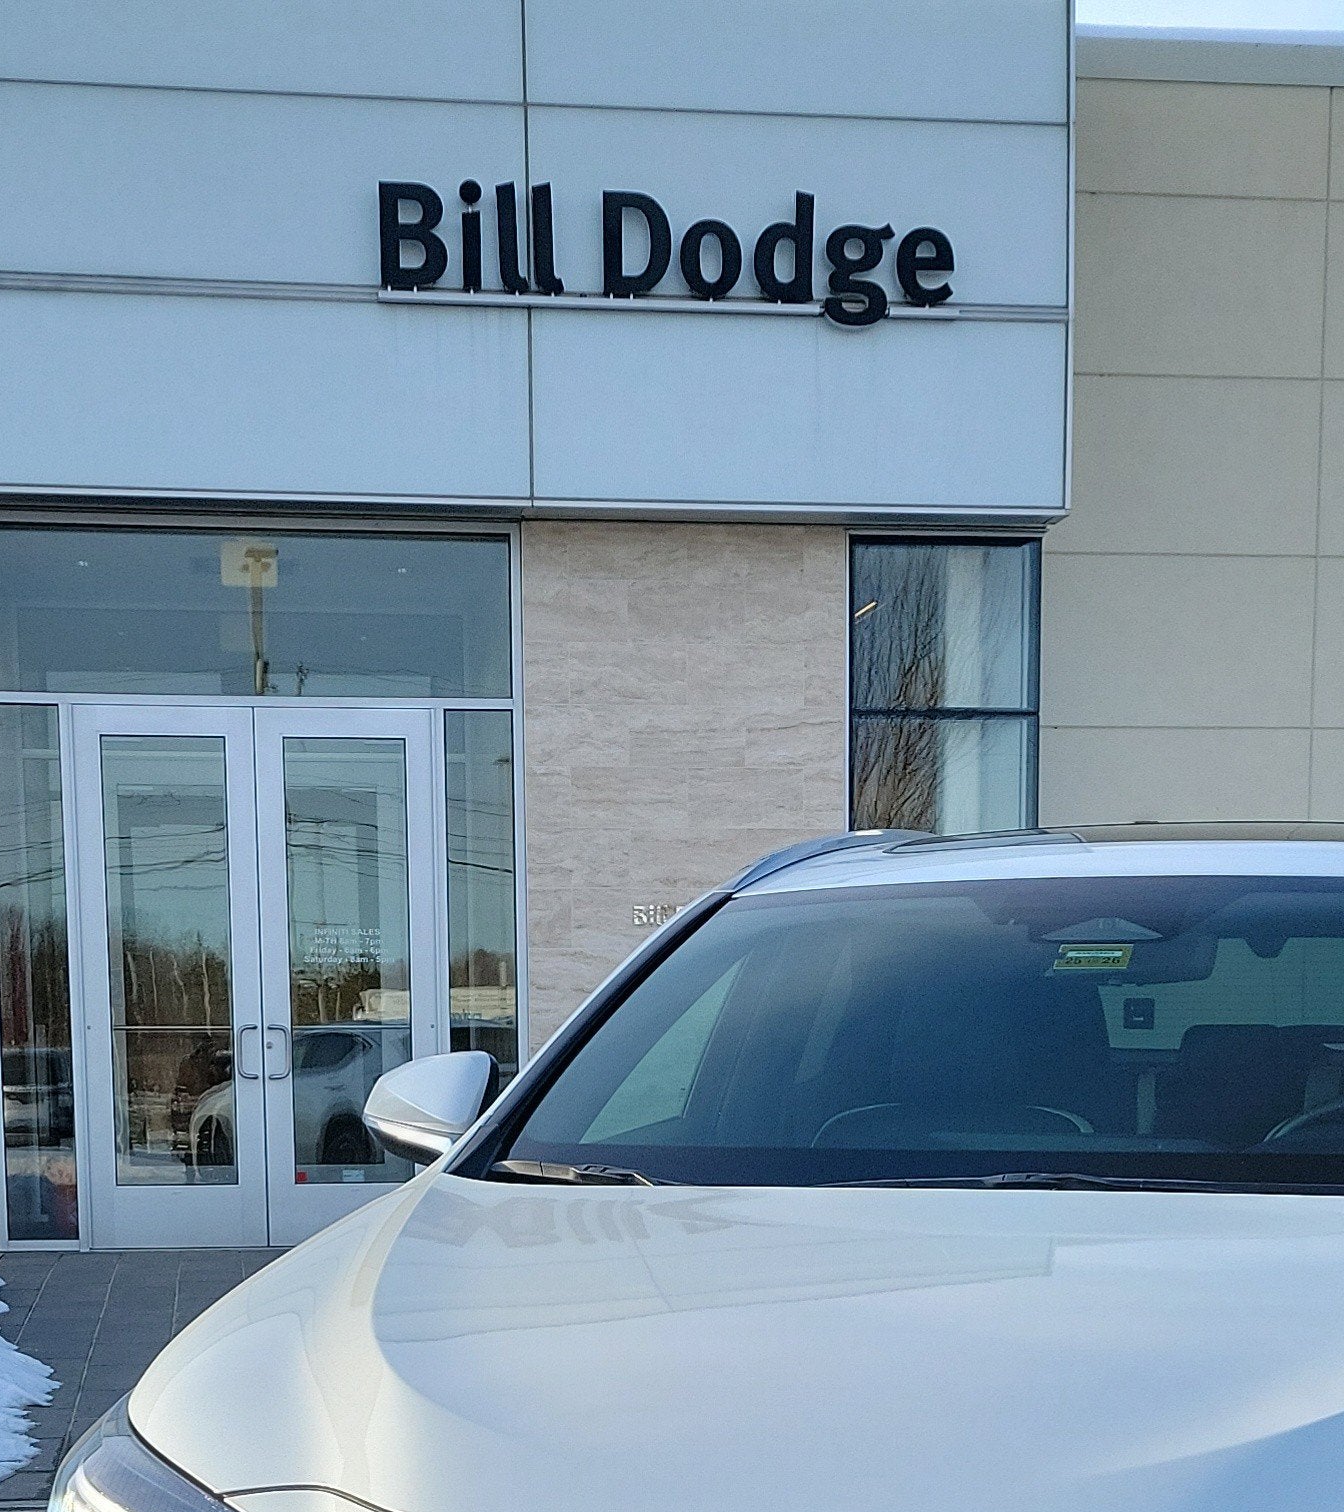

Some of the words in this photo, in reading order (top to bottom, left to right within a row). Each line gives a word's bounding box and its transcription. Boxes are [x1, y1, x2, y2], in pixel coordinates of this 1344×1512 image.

[378, 178, 565, 295] Bill
[602, 189, 955, 326] Dodge
[315, 928, 349, 936] INFINITI
[351, 928, 381, 936] SALES
[310, 946, 337, 956] Friday
[304, 955, 343, 964] Saturday
